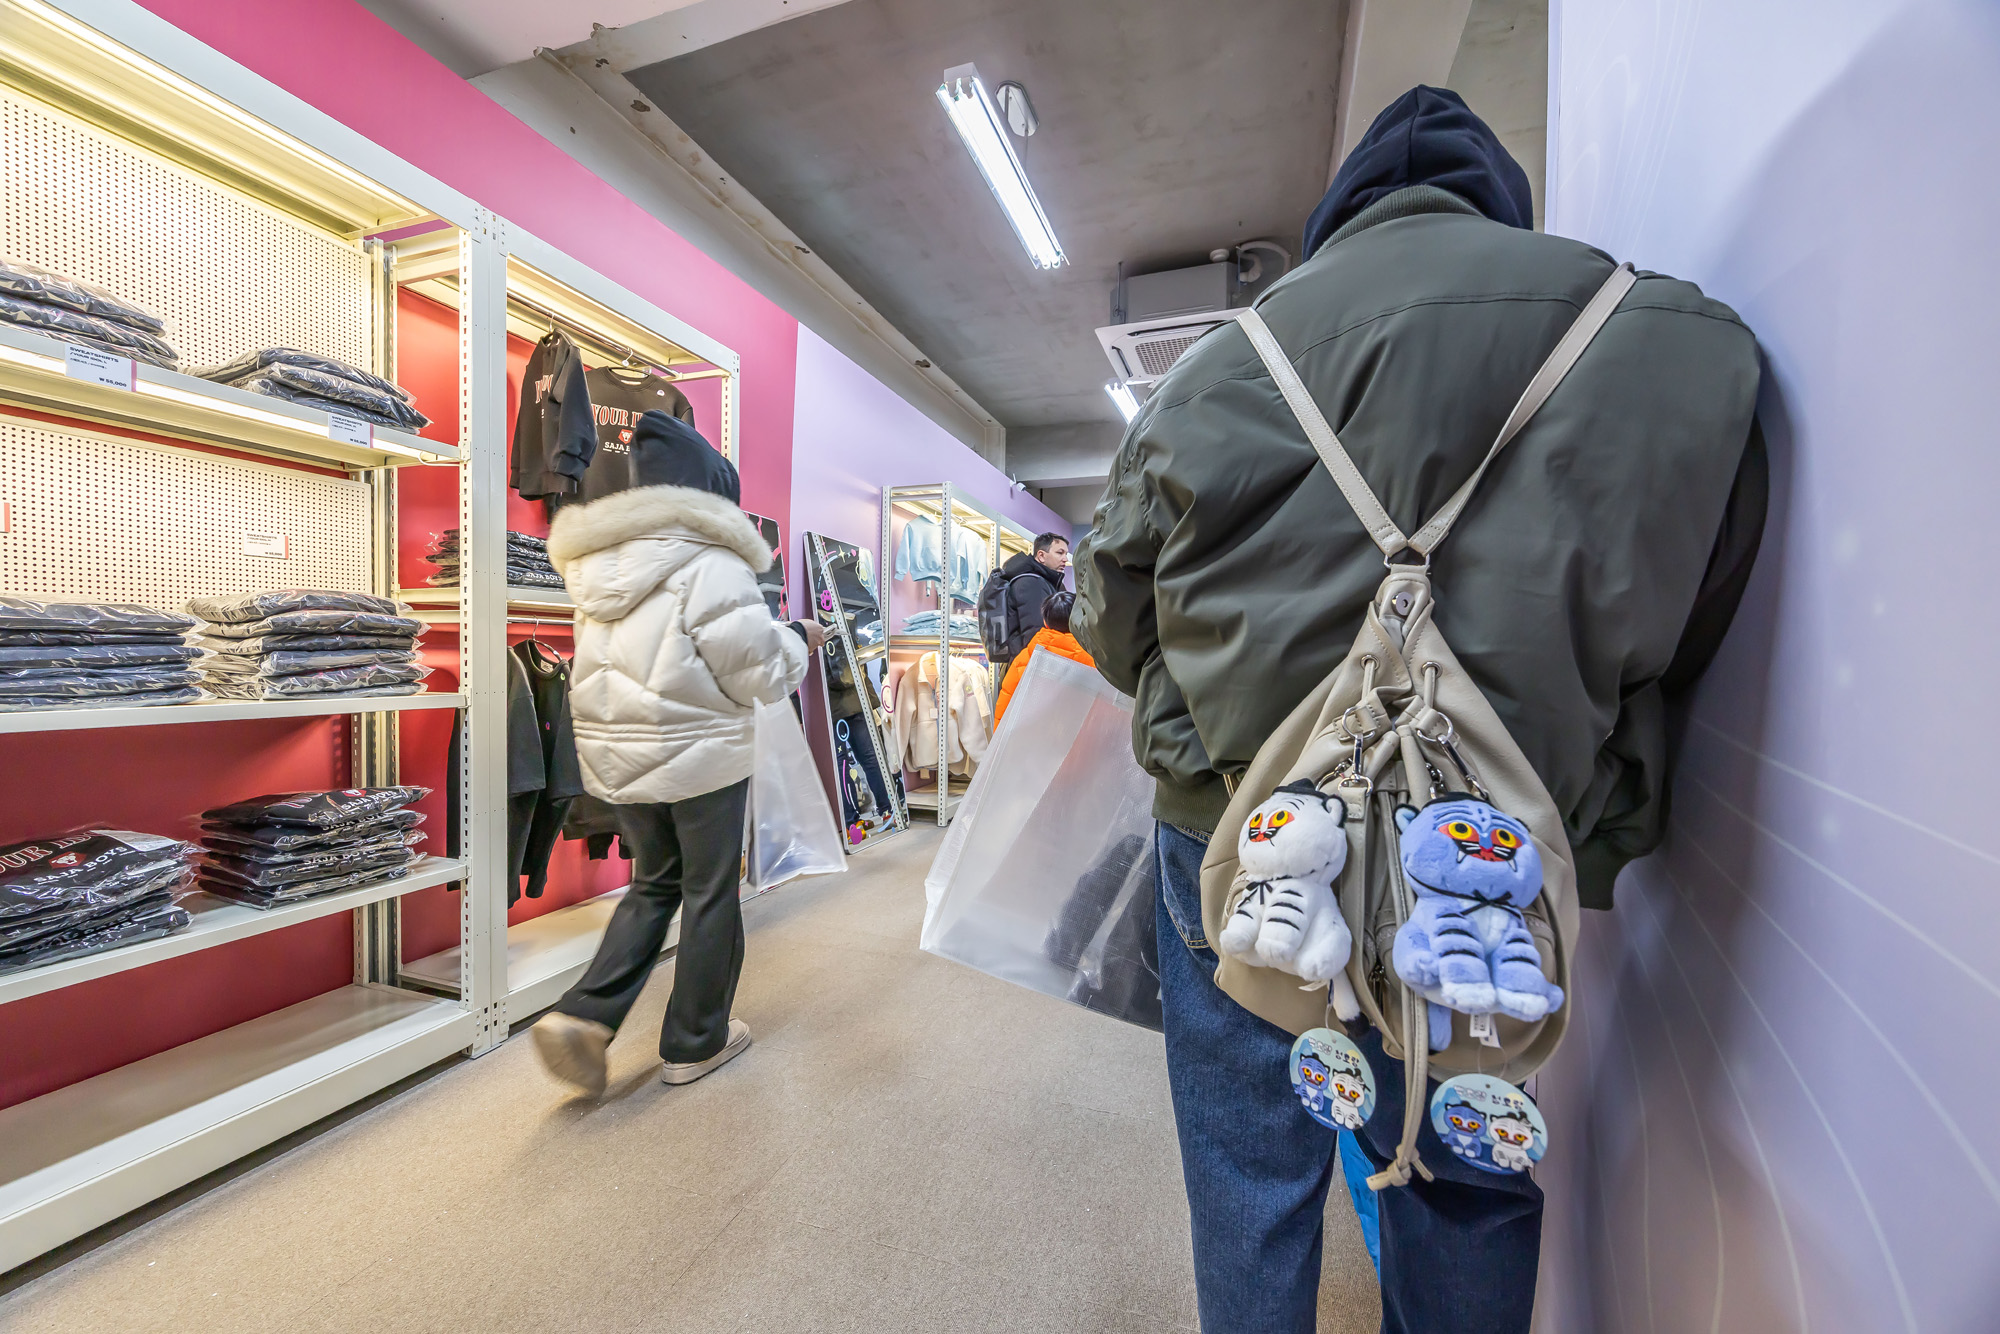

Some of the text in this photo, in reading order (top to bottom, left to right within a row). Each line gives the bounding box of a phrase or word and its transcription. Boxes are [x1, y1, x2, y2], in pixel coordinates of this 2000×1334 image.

[70, 346, 119, 363] SWEATSHIRTS
[605, 441, 624, 452] SAJA
[341, 795, 371, 811] SAJA
[33, 867, 84, 882] SAJA
[85, 846, 128, 868] BOYS
